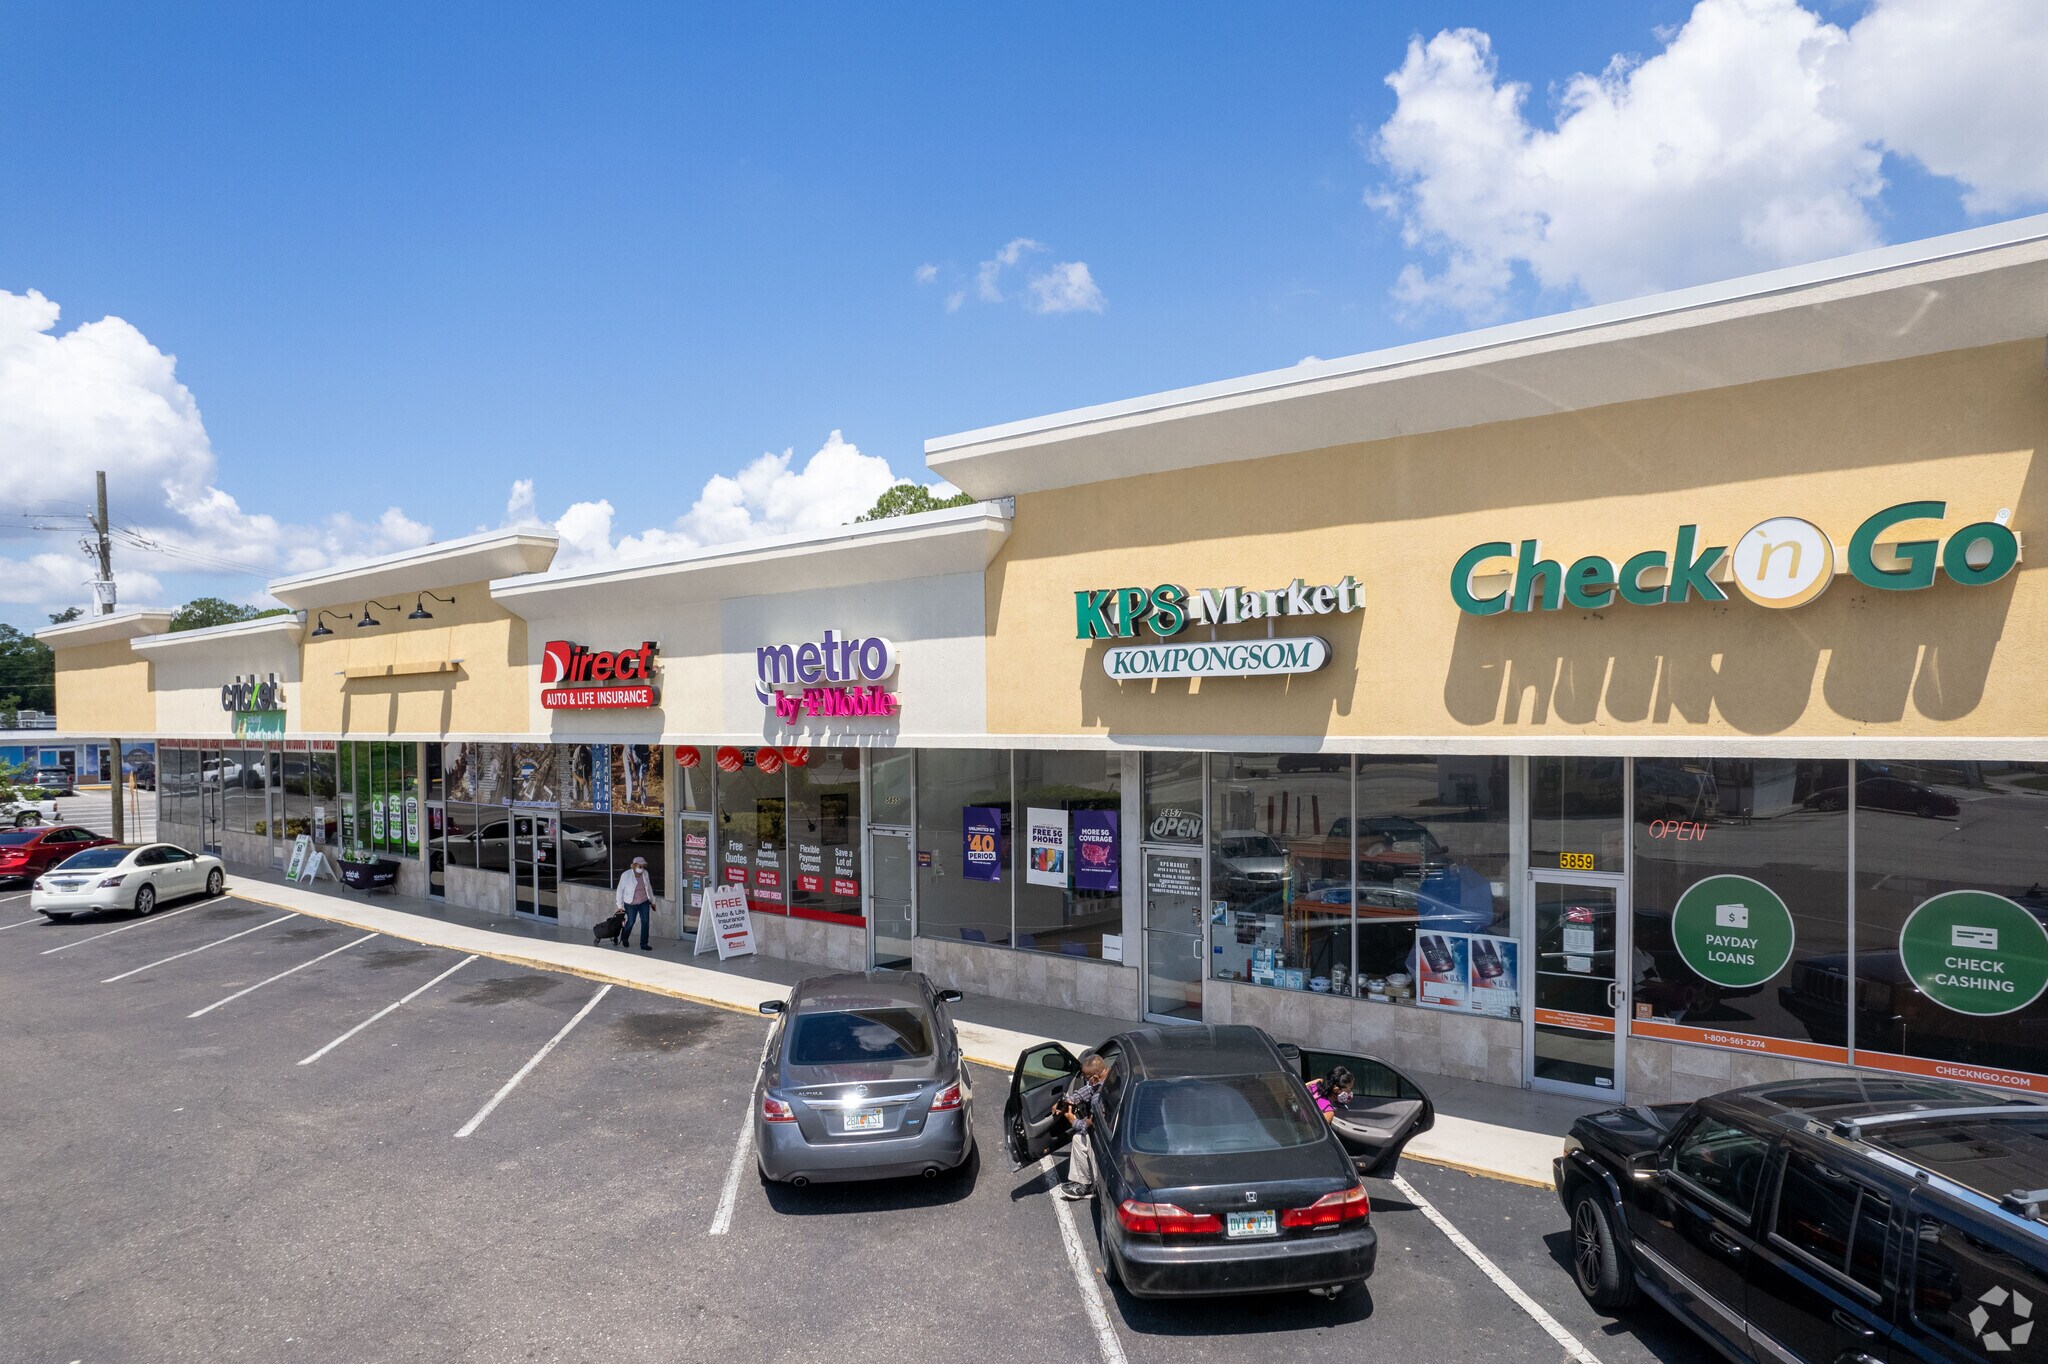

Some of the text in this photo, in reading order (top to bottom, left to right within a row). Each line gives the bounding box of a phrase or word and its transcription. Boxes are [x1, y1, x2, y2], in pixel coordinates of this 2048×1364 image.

[1450, 524, 1728, 616] Check
[1847, 500, 2019, 590] Go
[1074, 575, 1357, 640] KPS Market
[540, 640, 657, 683] Direct
[756, 629, 894, 685] metro
[1112, 642, 1314, 675] KOMPONGSOM
[222, 672, 279, 712] cricket
[546, 690, 648, 706] AUTO & LIFE INSURANCE
[774, 690, 803, 725] by
[1161, 808, 1182, 817] 5857
[390, 820, 401, 830] FREE
[1153, 816, 1200, 838] OPEN
[1648, 820, 1708, 842] OPEN
[729, 840, 742, 851] Free
[762, 841, 772, 850] Low
[1032, 836, 1063, 845] PHONES
[758, 850, 777, 860] Monthly
[800, 844, 820, 854] Flexible
[835, 848, 848, 857] Save
[726, 852, 747, 864] Quotes
[756, 859, 779, 868] Payments
[799, 853, 821, 864] Payment
[836, 858, 844, 866] Lot
[1561, 854, 1592, 868] 5859
[801, 862, 820, 872] Options
[835, 867, 854, 878] Money
[771, 892, 782, 900] CHECK
[714, 897, 742, 909] FREE
[718, 916, 745, 924] Insurance
[1706, 934, 1758, 949] PAYDAY
[1708, 950, 1755, 965] LOANS
[1944, 956, 2004, 974] CHECK
[1934, 972, 2015, 993] CASHING
[1704, 1033, 1766, 1048] 1-800-561-2274
[1935, 1065, 2030, 1087] CHECKNGO.COM
